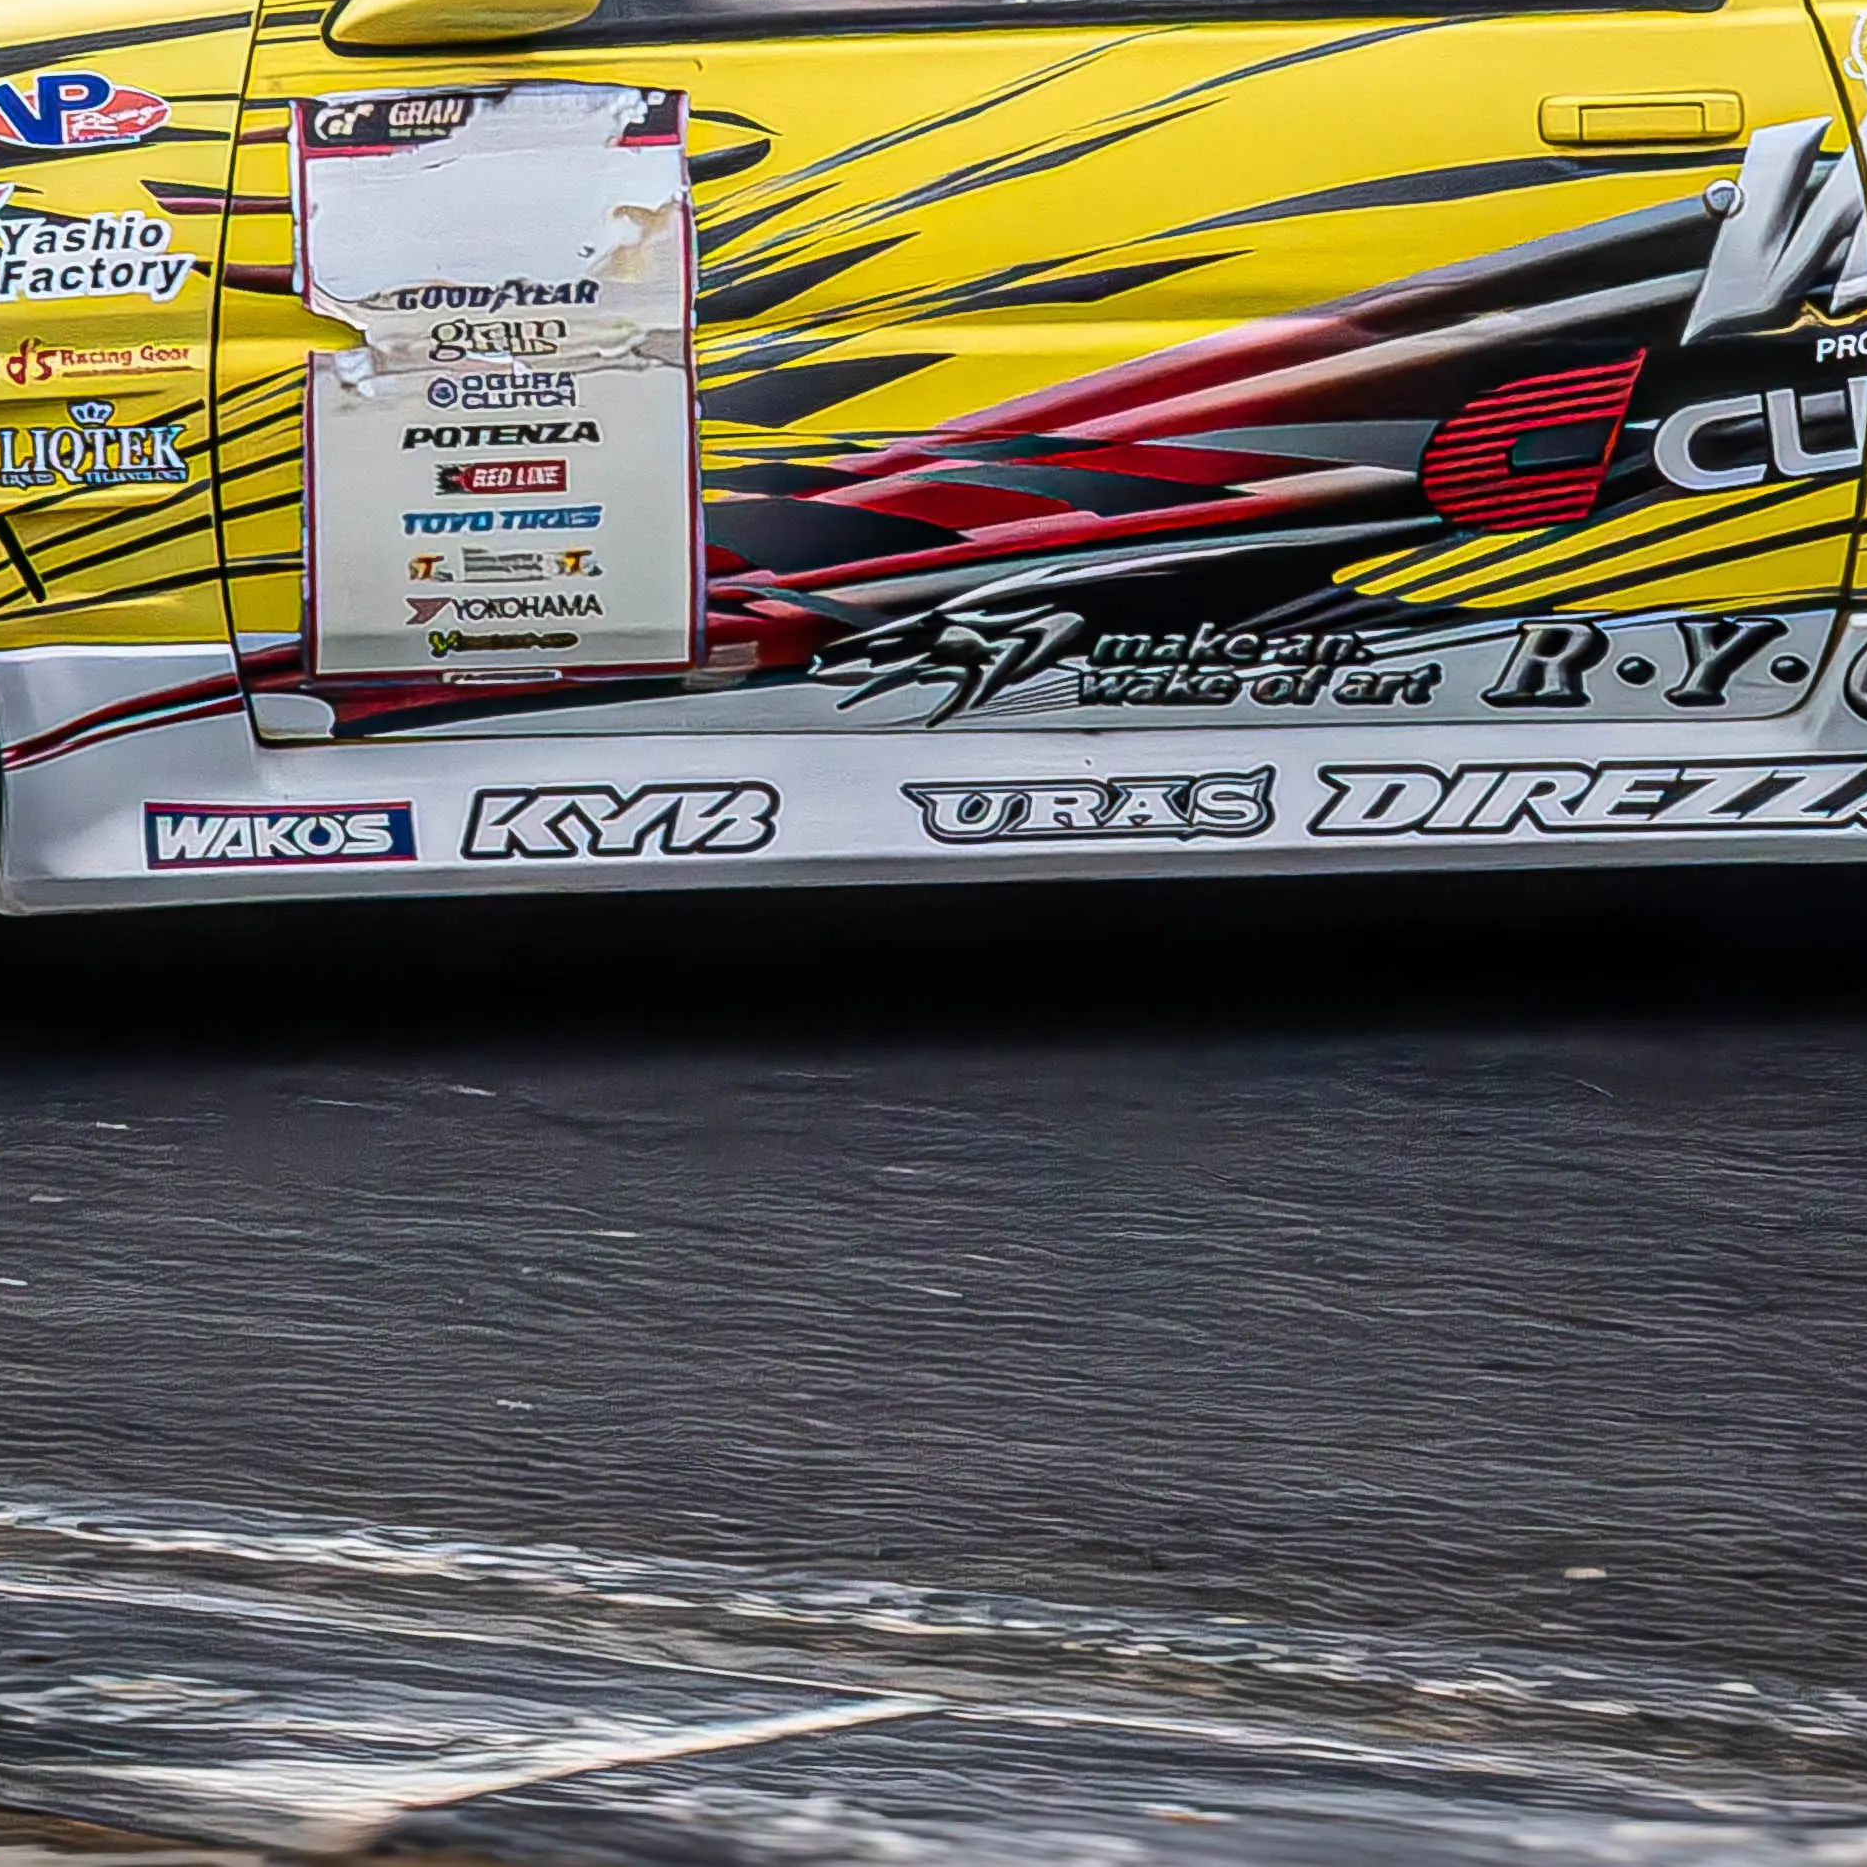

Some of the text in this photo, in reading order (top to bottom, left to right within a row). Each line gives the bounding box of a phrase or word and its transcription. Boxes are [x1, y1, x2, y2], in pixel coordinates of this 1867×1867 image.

[388, 98, 466, 126] GRAN
[1, 218, 163, 255] Yashio
[461, 372, 576, 392] OGURA
[461, 390, 578, 410] CLUTCH
[402, 421, 601, 450] POTENZA
[402, 510, 495, 534] TOYO
[451, 593, 605, 621] YOKOHAMA
[904, 766, 1274, 843] URAS
[463, 782, 778, 860] KYB
